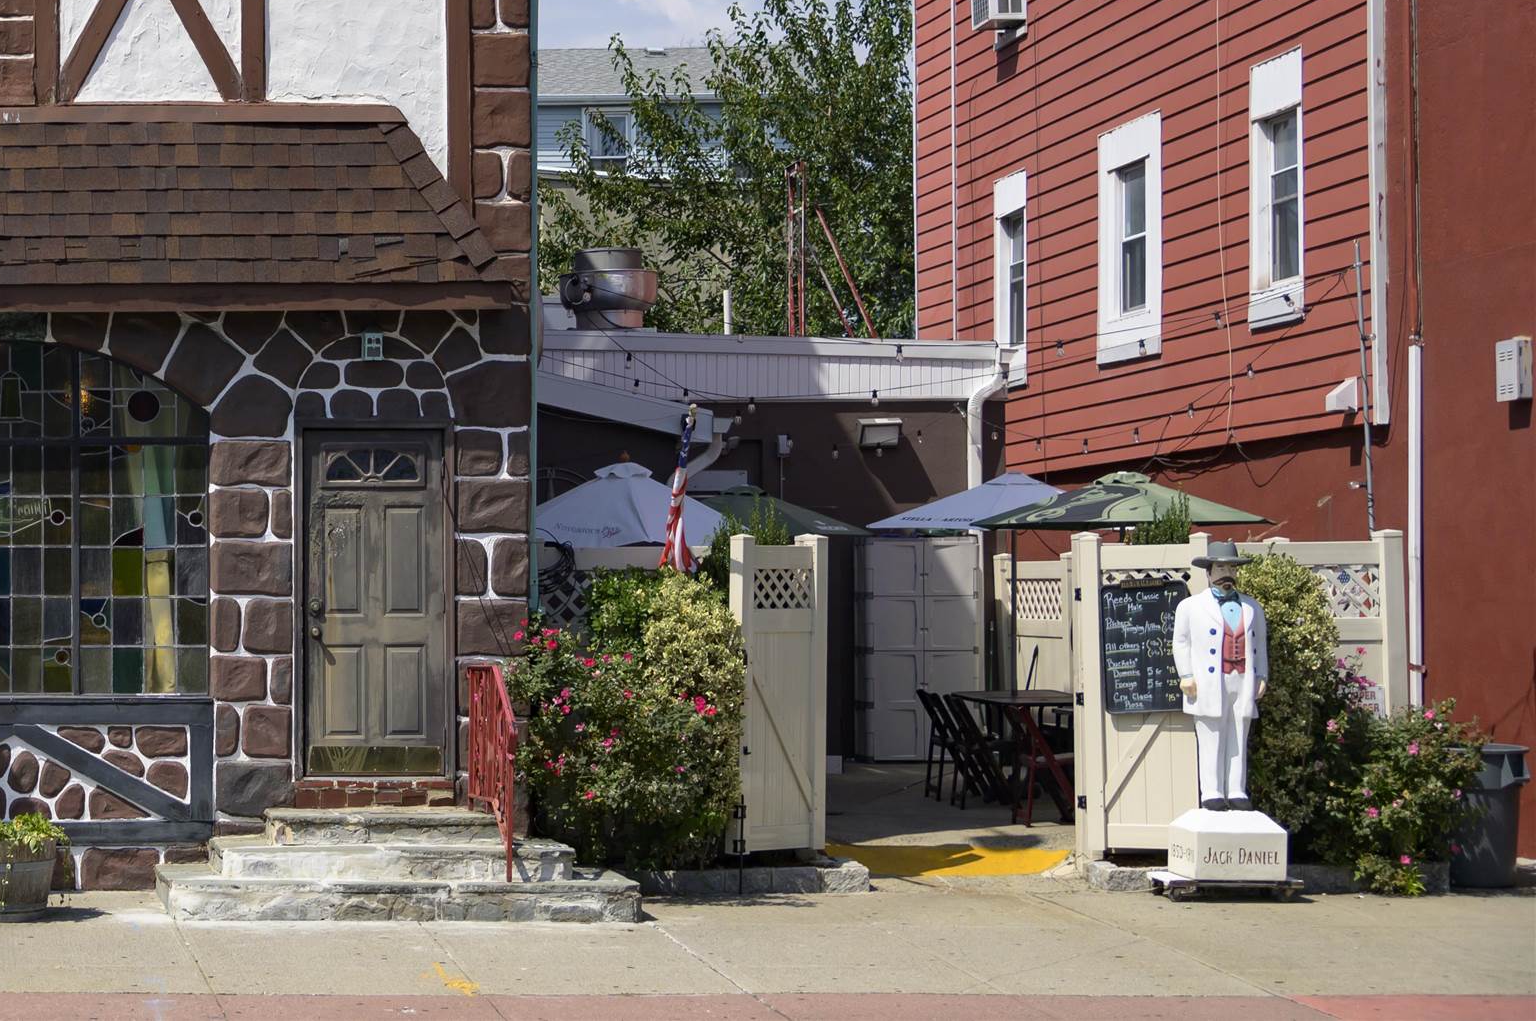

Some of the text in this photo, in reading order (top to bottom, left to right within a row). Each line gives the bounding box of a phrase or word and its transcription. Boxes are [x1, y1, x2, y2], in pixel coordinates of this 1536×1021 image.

[1106, 643, 1116, 651] All
[1147, 667, 1153, 676] 5
[1147, 679, 1153, 689] 5
[1204, 846, 1281, 865] JACK DANIEL
